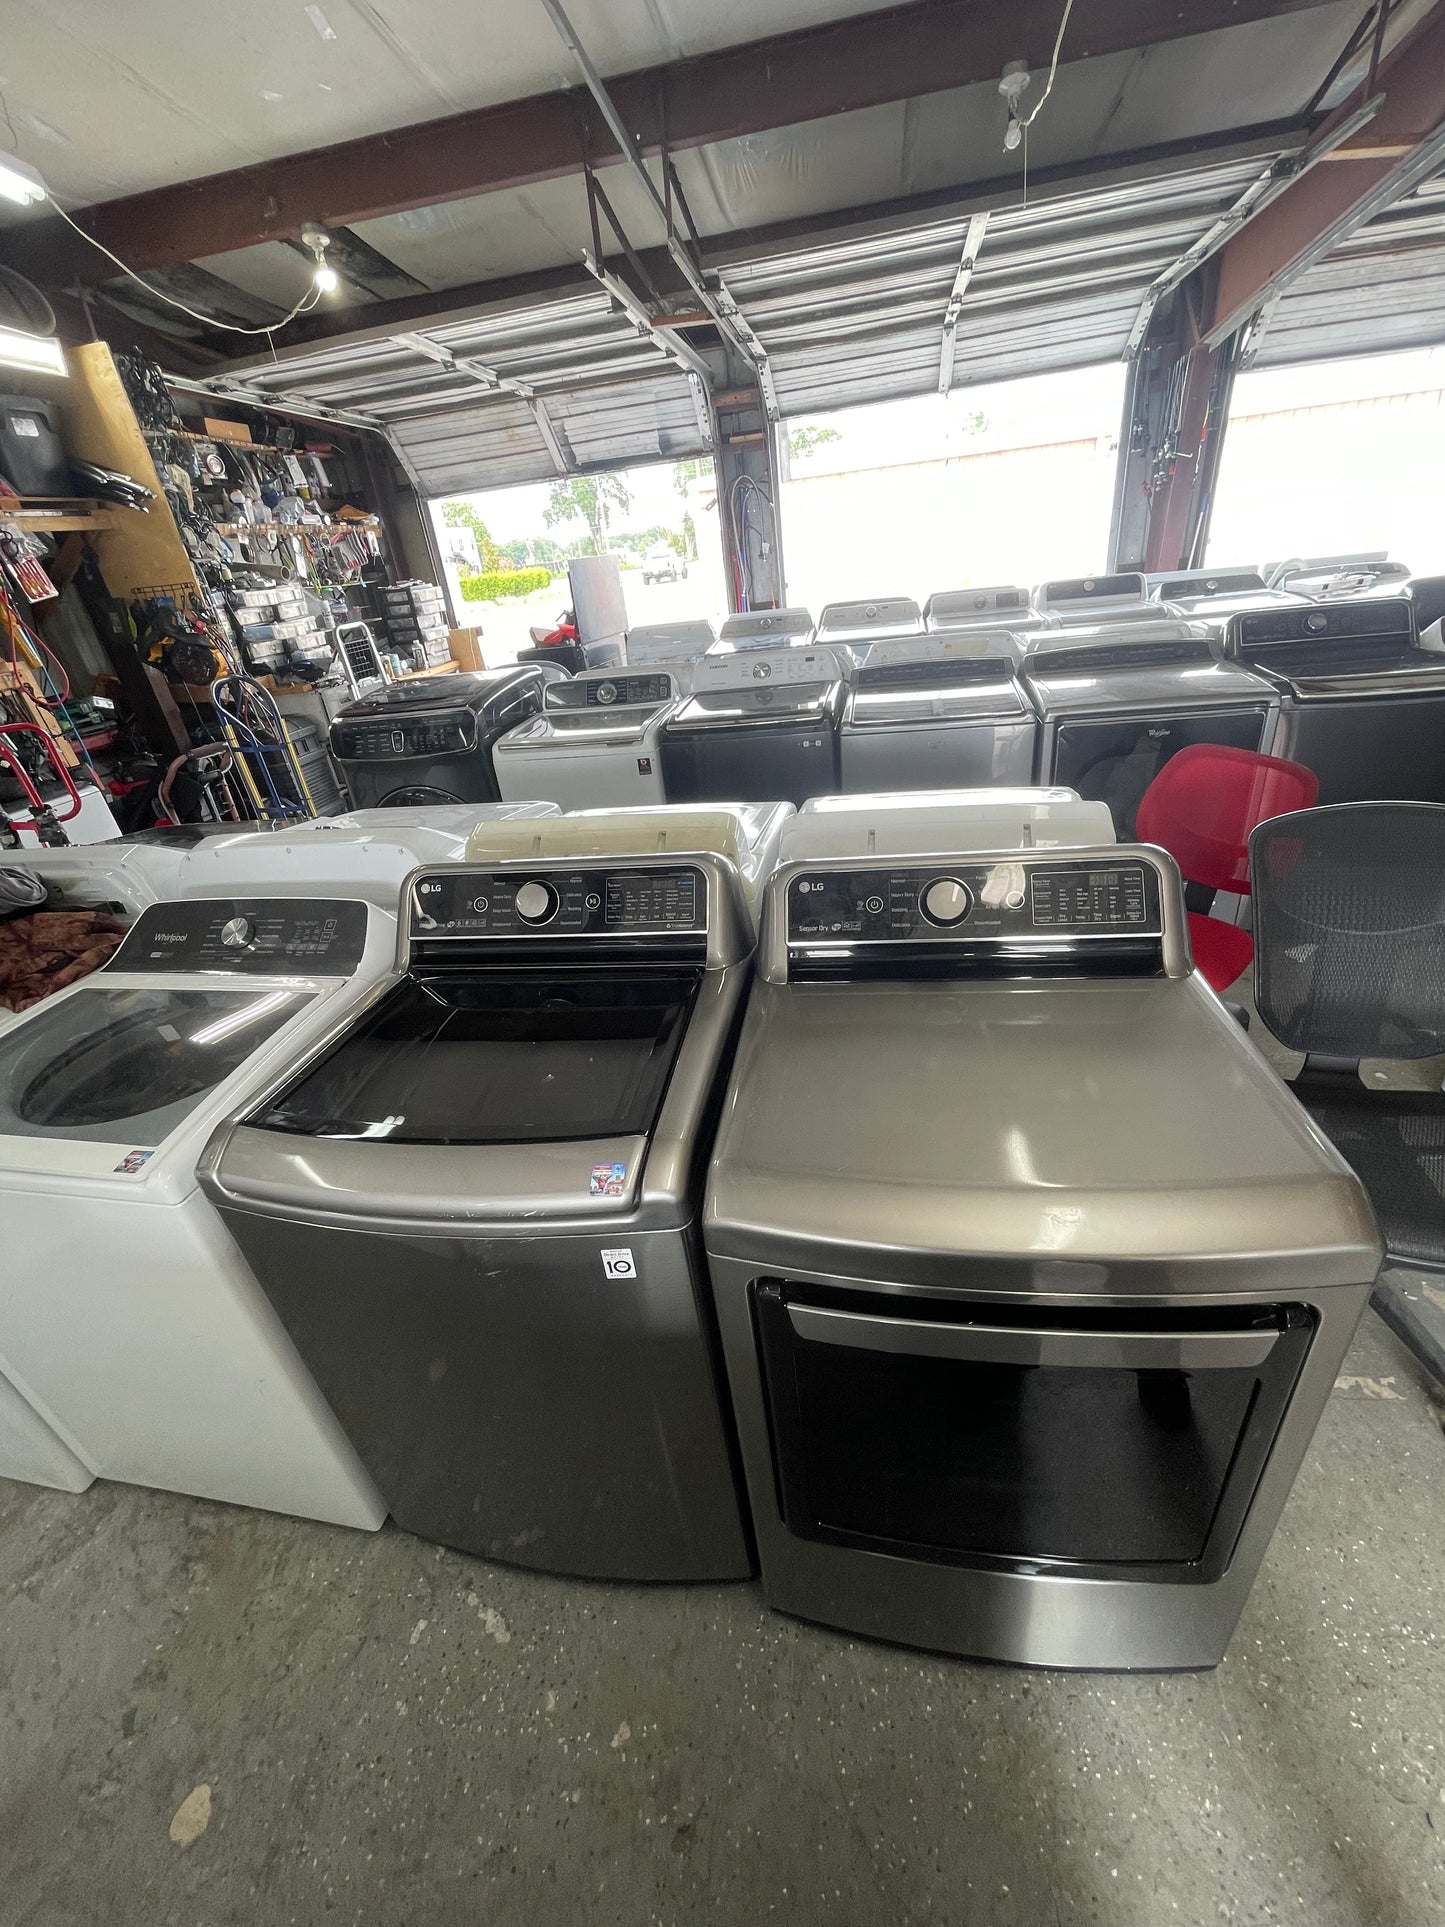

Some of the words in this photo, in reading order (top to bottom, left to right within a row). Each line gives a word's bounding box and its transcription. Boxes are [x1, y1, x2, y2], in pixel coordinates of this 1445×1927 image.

[431, 884, 442, 892] LG
[811, 883, 824, 891] LG
[819, 925, 829, 933] Dry
[154, 932, 188, 943] Whirlpool
[606, 1260, 632, 1274] 10
